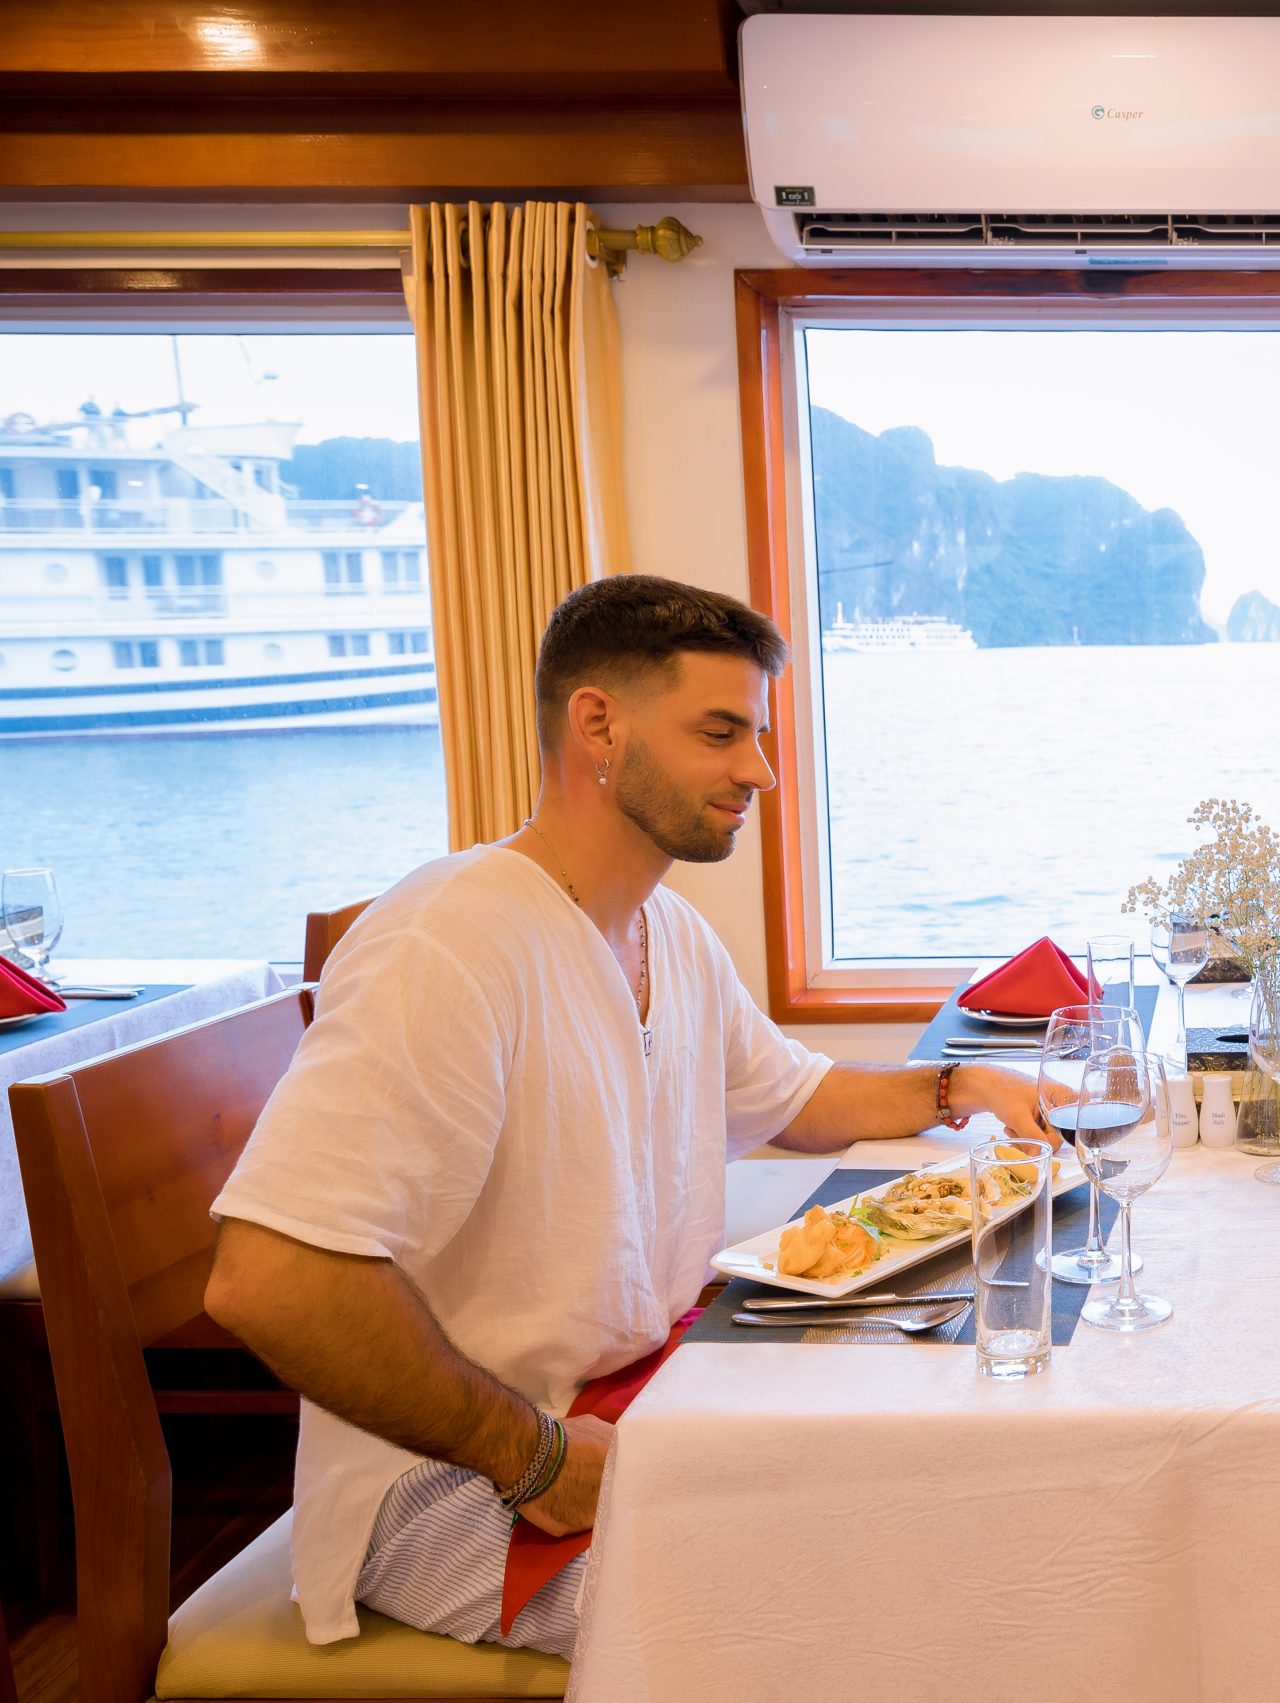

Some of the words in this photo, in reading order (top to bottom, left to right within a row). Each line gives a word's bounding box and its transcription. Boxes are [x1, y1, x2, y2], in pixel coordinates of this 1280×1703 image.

[1107, 108, 1144, 121] Casper
[781, 191, 787, 200] 1
[803, 191, 809, 200] 1
